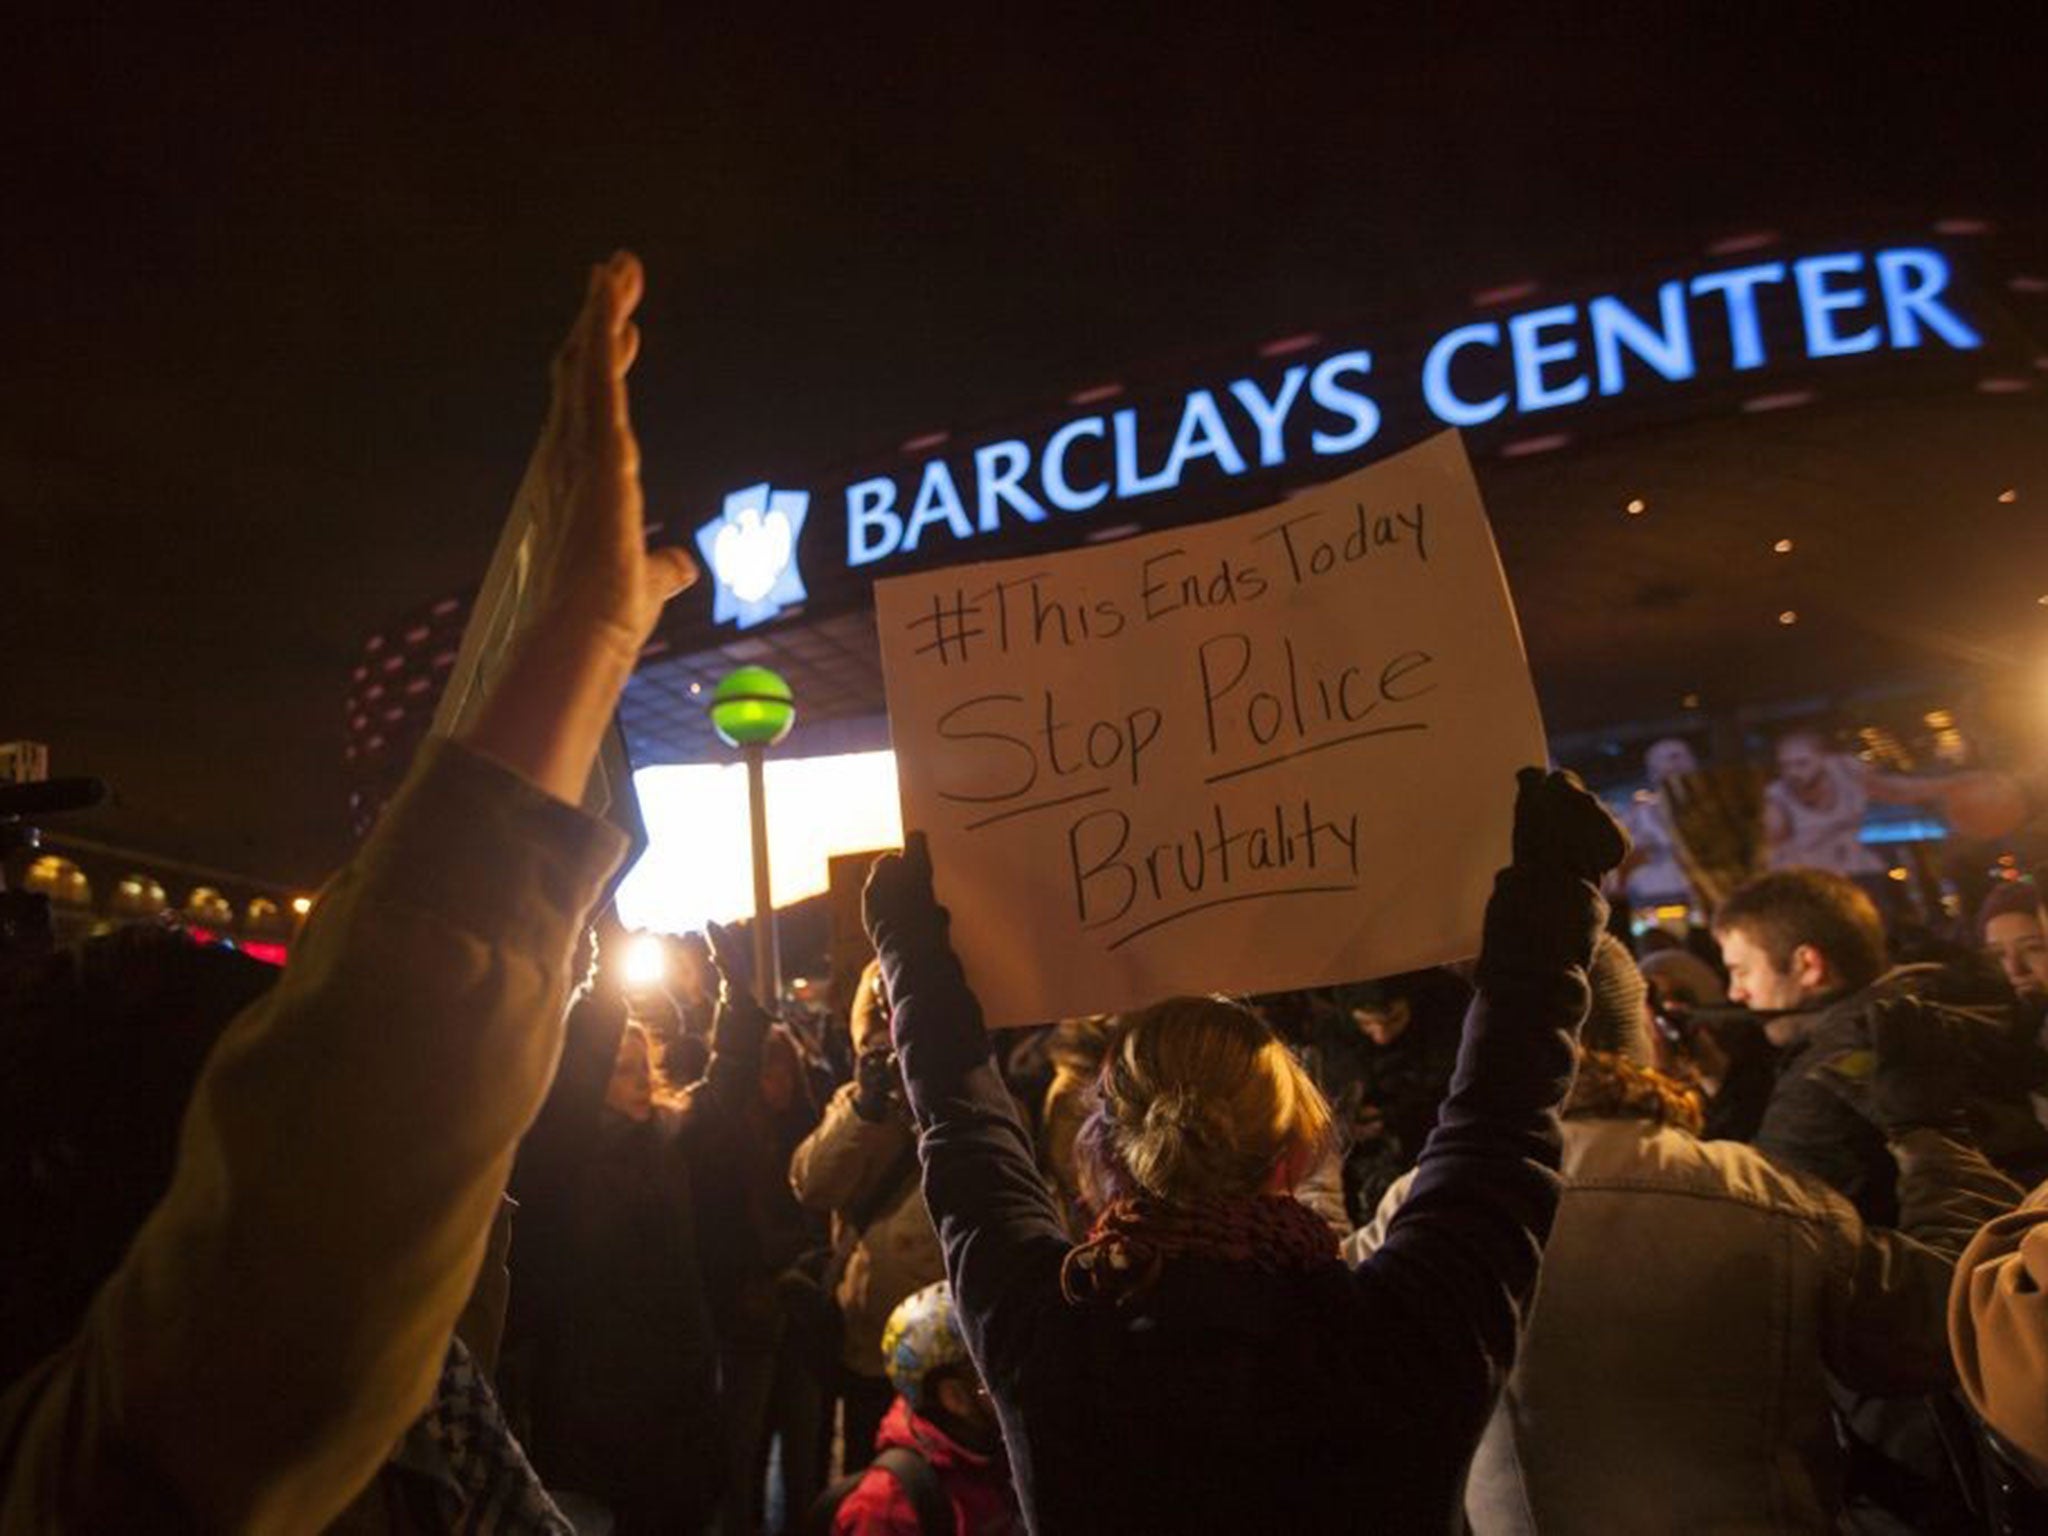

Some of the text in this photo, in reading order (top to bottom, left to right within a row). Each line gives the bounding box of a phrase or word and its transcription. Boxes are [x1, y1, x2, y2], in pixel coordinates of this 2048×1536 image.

[846, 246, 1984, 567] BARCLAYS CENTER
[937, 633, 1438, 803] Stop Police
[1068, 800, 1359, 931] Brutality
